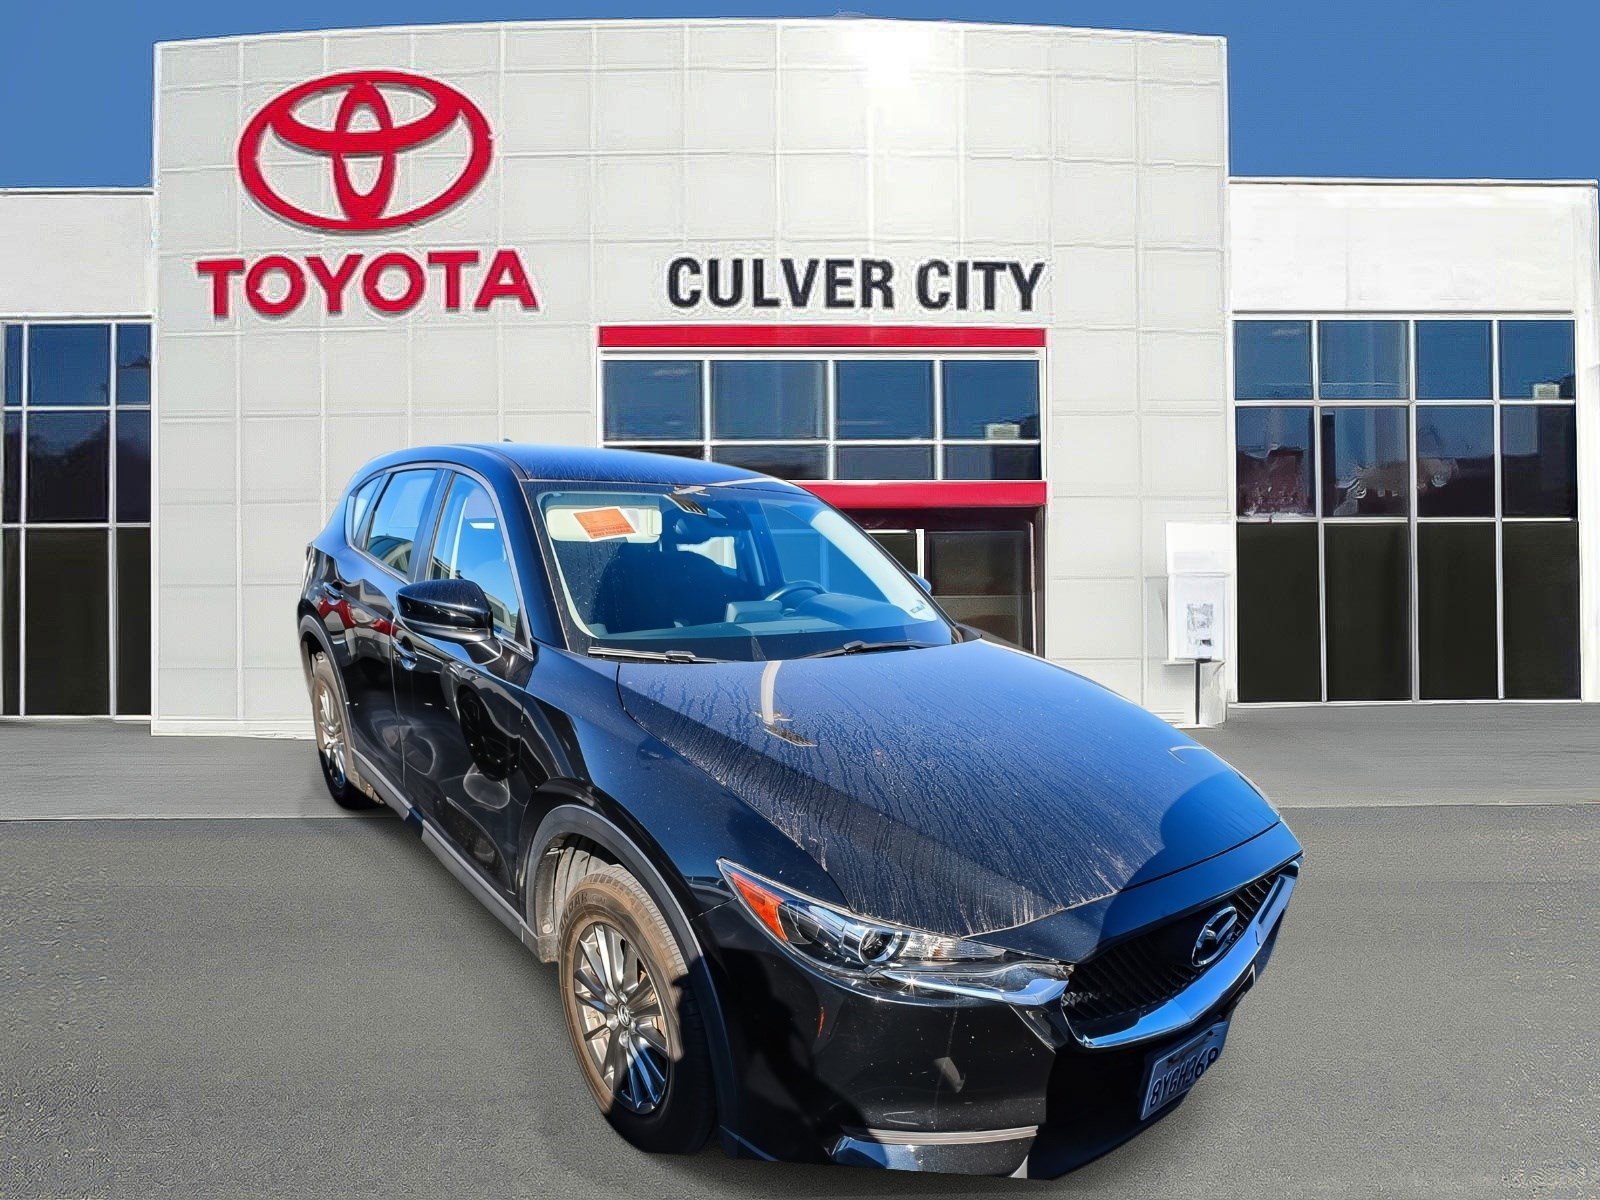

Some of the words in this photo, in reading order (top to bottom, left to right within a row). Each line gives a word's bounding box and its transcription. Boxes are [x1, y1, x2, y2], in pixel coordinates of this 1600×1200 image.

[197, 250, 538, 317] TOYOTA
[668, 257, 895, 309] CULVER
[916, 259, 1046, 311] CITY
